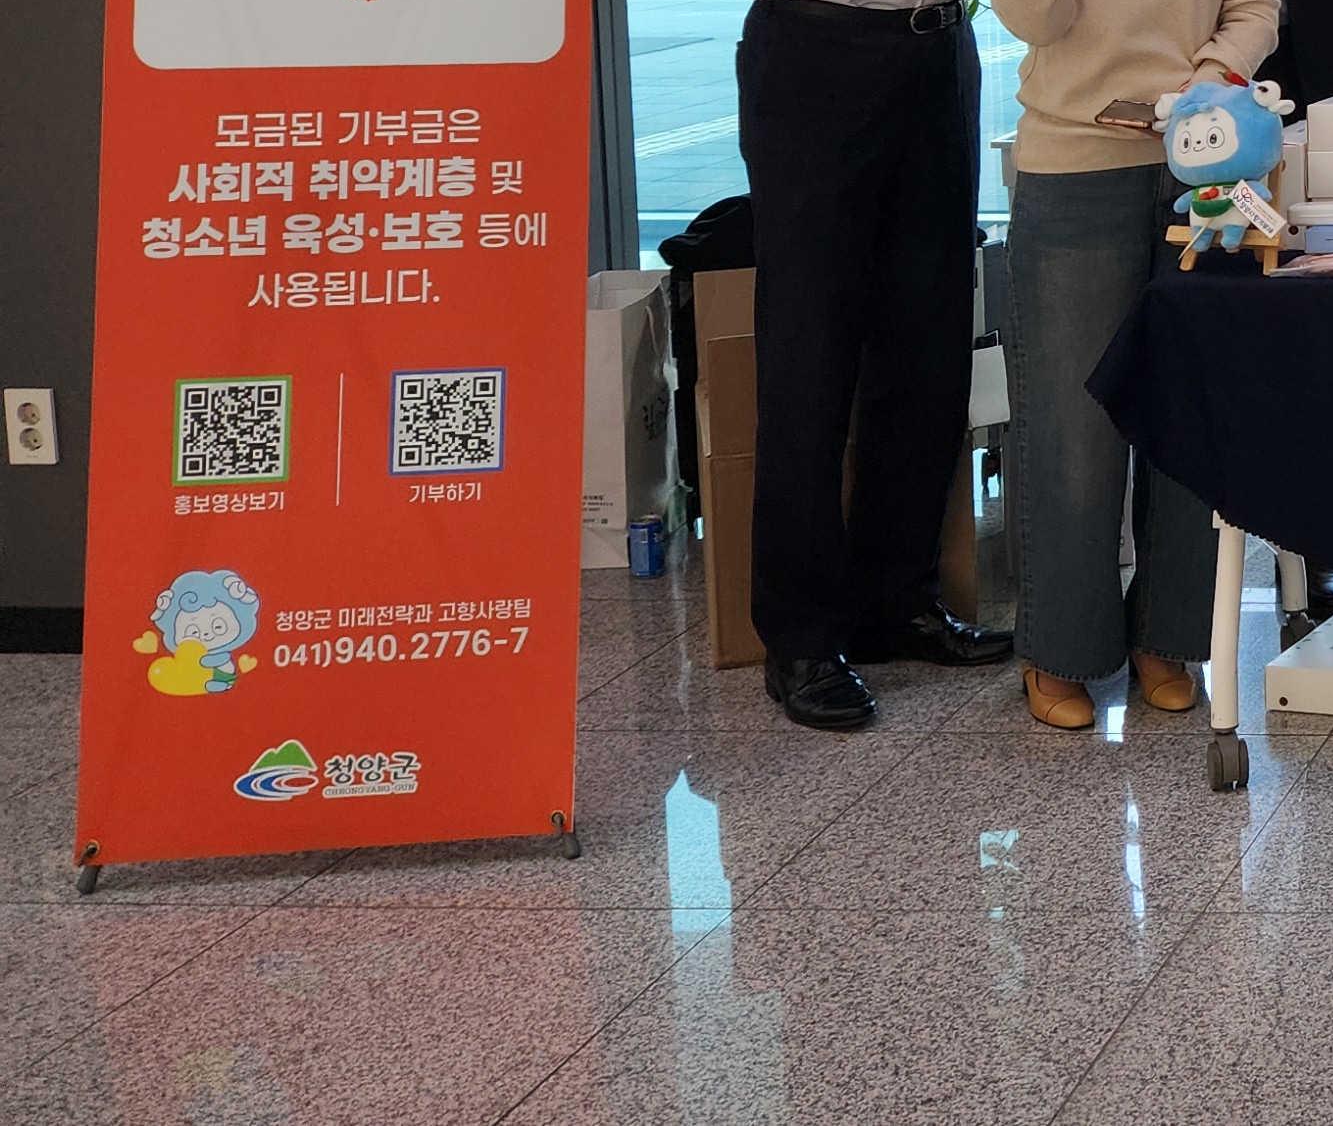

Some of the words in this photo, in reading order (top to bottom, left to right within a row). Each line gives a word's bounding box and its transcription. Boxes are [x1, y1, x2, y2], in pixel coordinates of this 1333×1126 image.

[216, 112, 324, 149] 모금된
[337, 107, 482, 146] 기부금은
[167, 162, 295, 205] 사회적
[308, 154, 477, 201] 취약계층
[490, 157, 524, 195] 및
[140, 215, 268, 260] 청소년
[476, 209, 548, 248] 등에
[247, 268, 441, 309] 사용됩니다.
[173, 490, 286, 516] 홍보영상보기
[408, 480, 483, 505] 기부하기
[275, 606, 332, 631] 청양군
[337, 602, 434, 629] 미래전략과
[438, 599, 532, 625] 고향사랑팀
[273, 626, 530, 669] 041)940.2776-7
[325, 753, 420, 784] 청양군
